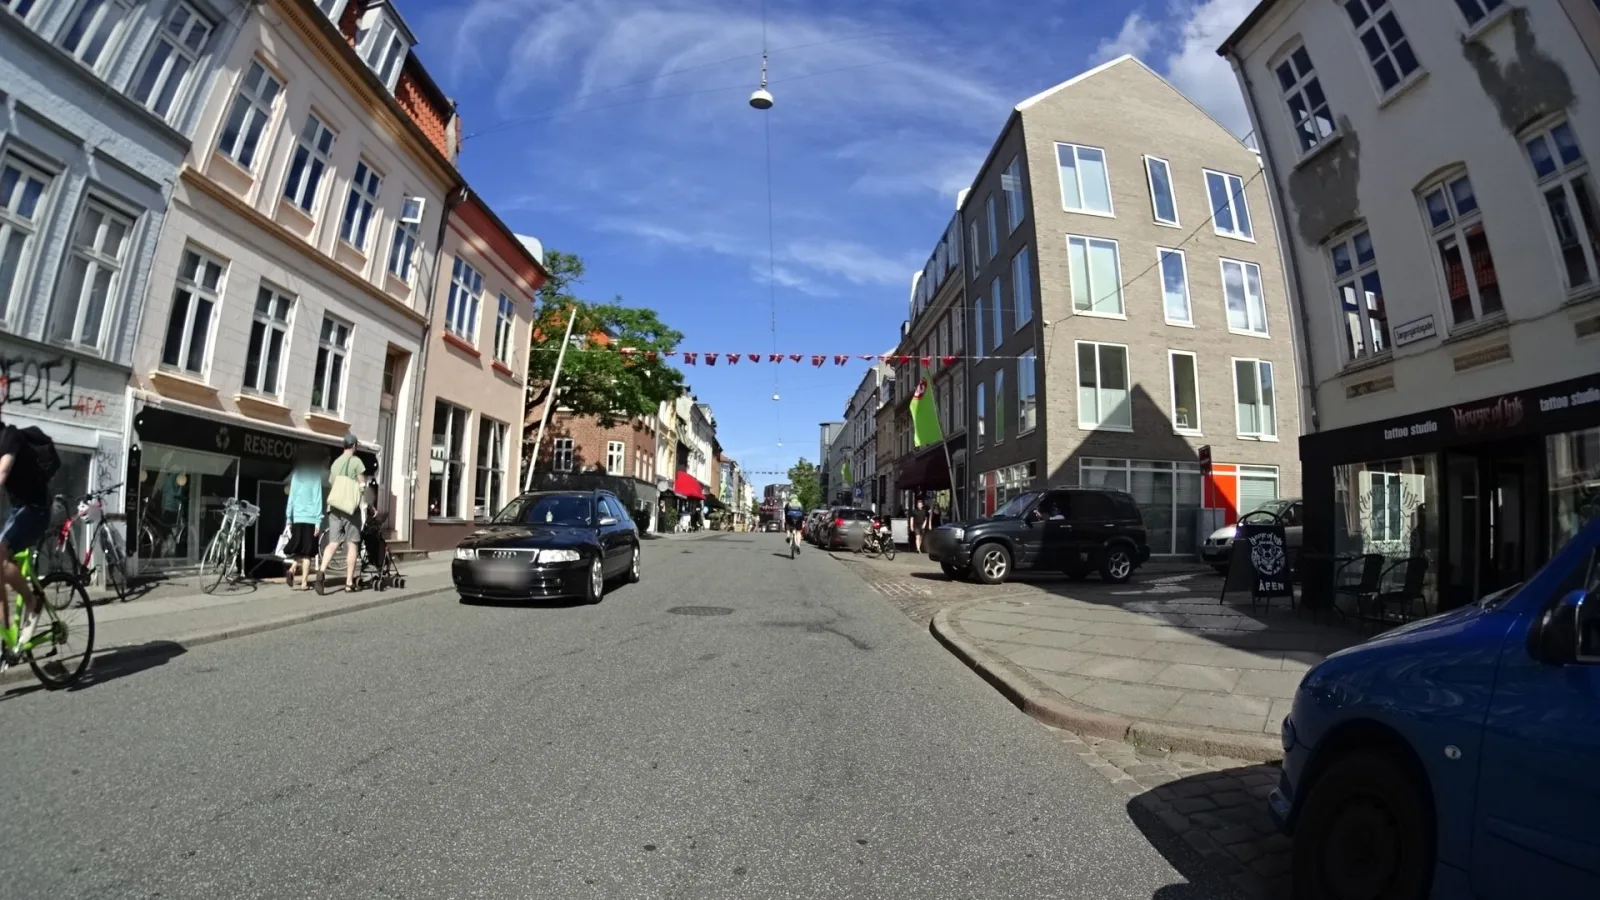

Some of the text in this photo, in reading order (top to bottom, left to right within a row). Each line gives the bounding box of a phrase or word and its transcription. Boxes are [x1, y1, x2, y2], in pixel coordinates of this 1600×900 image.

[1539, 387, 1600, 412] tattoo studio
[1384, 420, 1438, 440] tattoo studio
